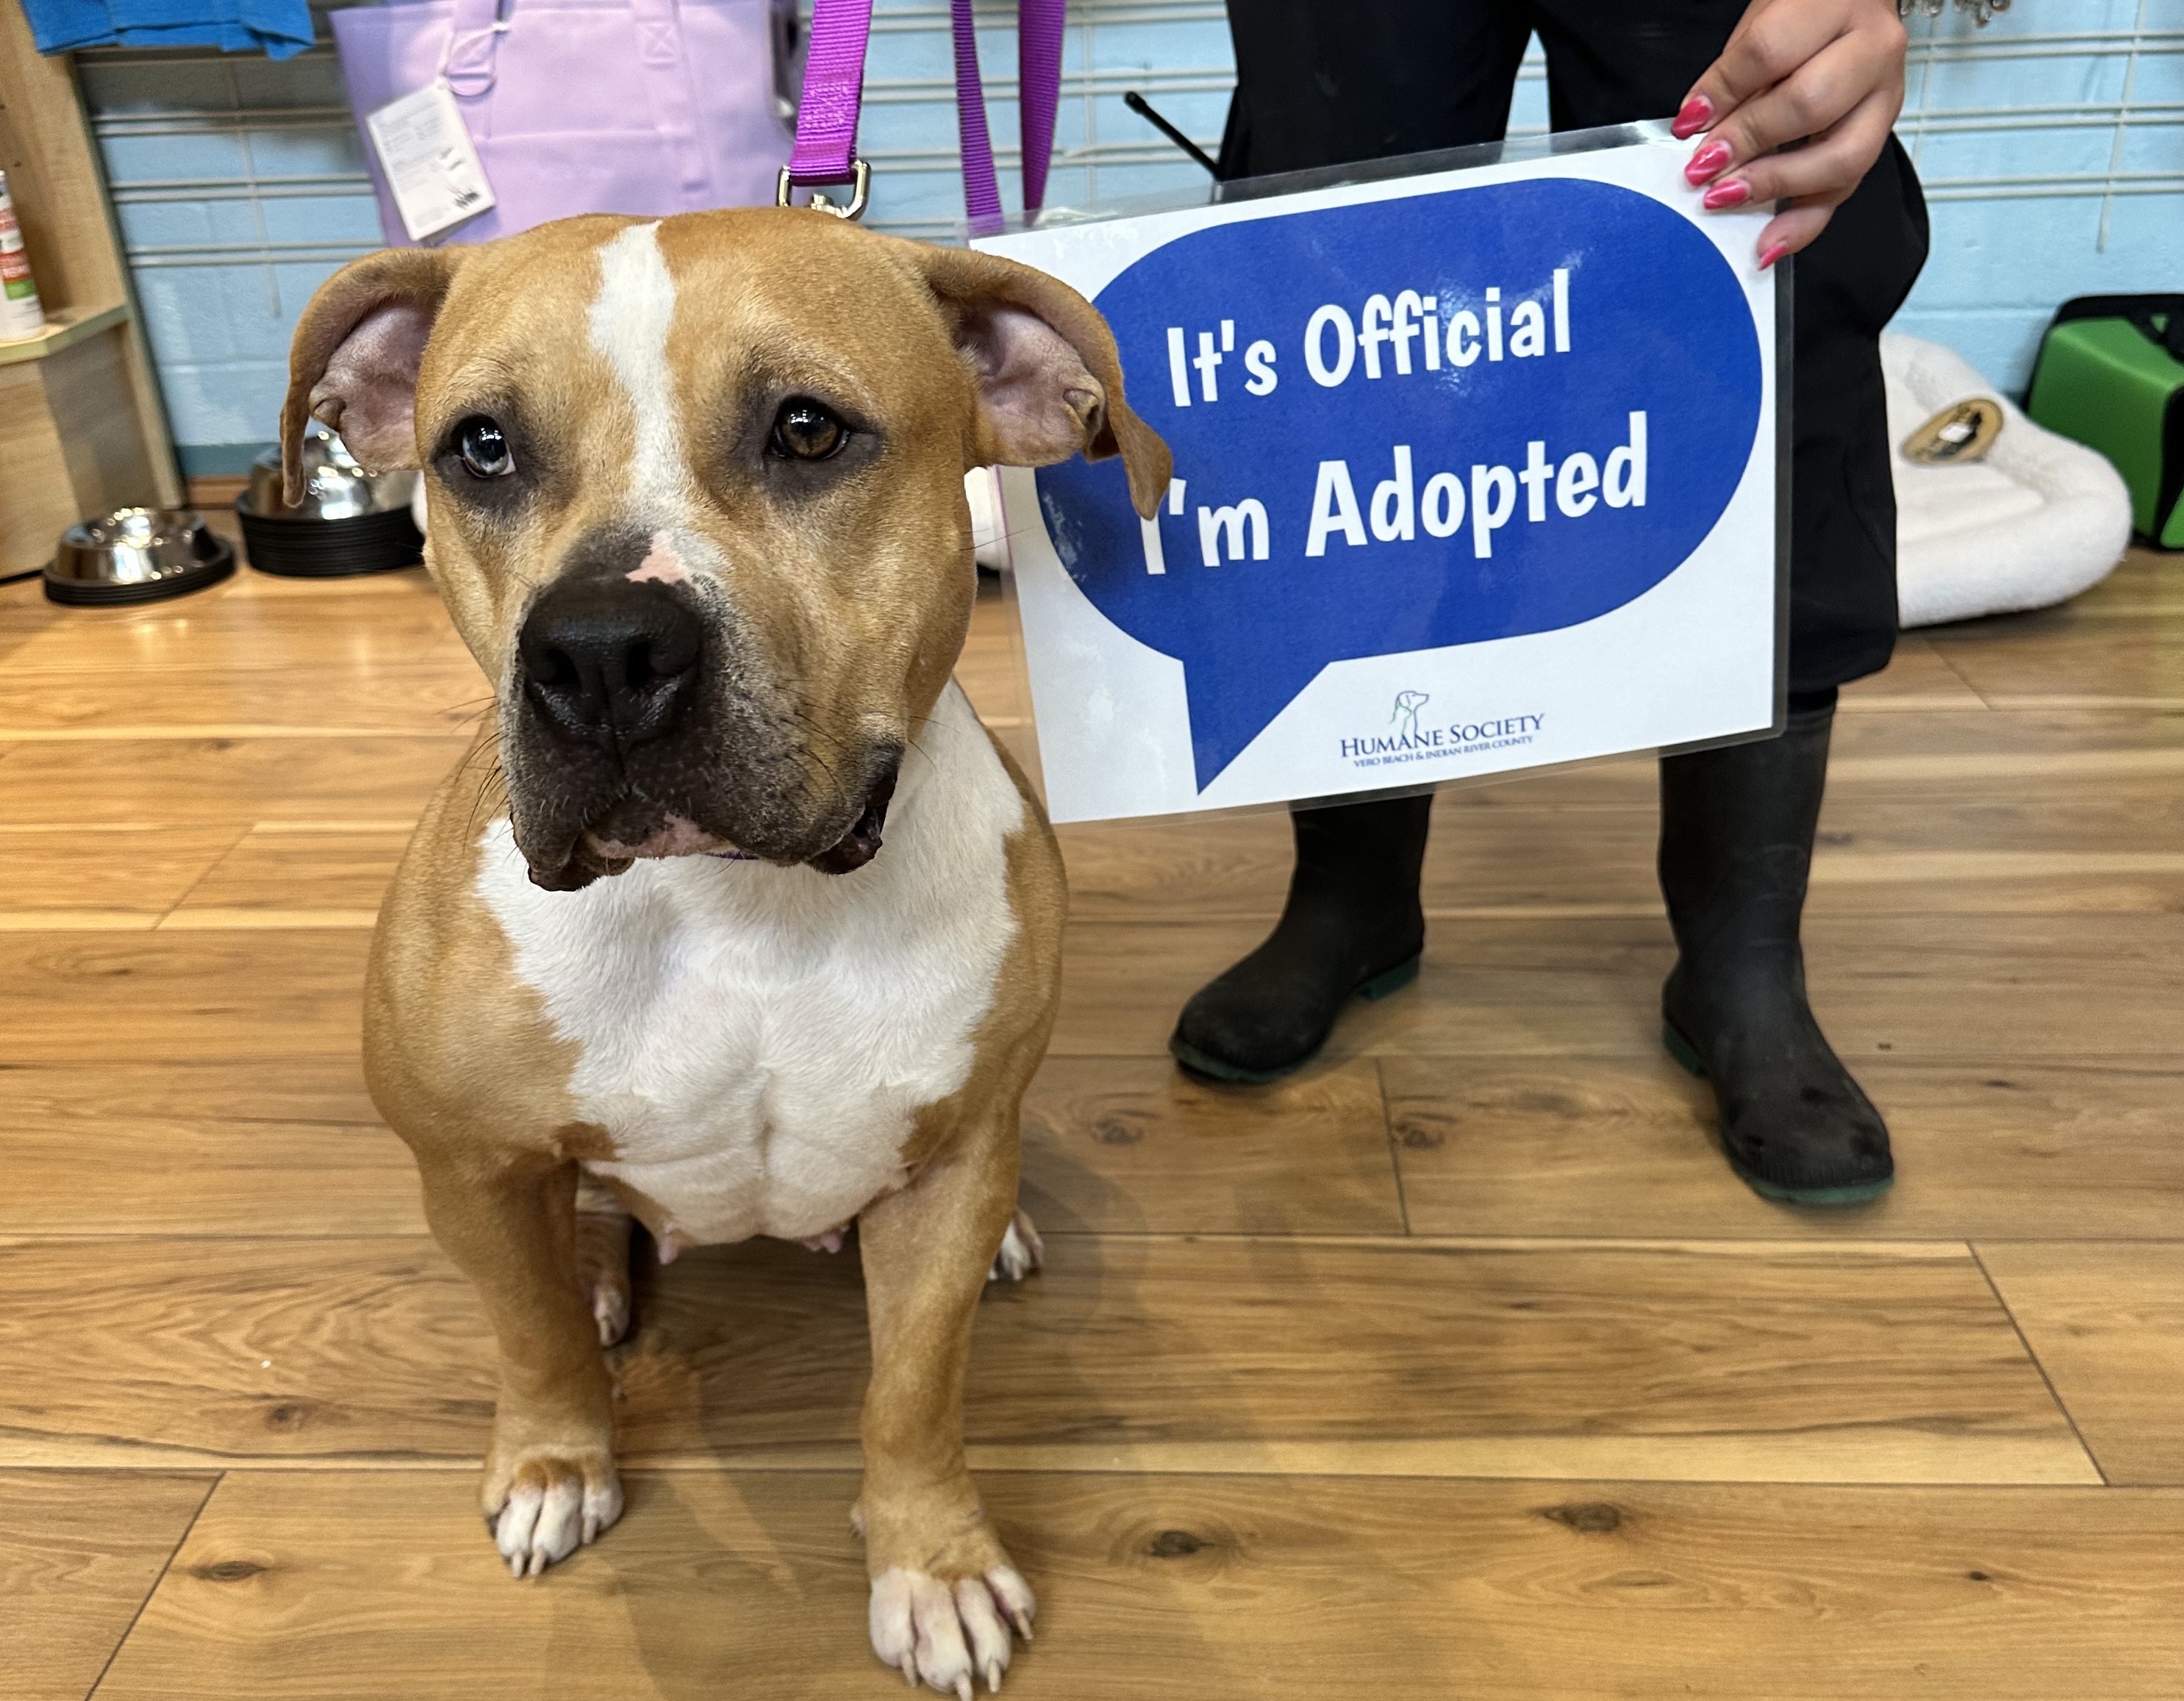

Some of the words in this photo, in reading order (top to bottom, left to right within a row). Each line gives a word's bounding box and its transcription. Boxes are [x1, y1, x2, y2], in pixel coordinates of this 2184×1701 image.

[1167, 319, 1278, 407] It's
[1304, 268, 1571, 387] Official
[1139, 477, 1270, 575] I'm
[1305, 410, 1647, 558] Adopted
[1340, 729, 1444, 758] HUMANE
[1449, 713, 1544, 745] SOCIETY
[1354, 758, 1381, 767] VERO
[1382, 753, 1414, 764] BEACH
[1415, 751, 1424, 761] &
[1425, 747, 1462, 759] INDIAN
[1463, 742, 1491, 753] RIVER
[1492, 735, 1533, 749] COUNTY
